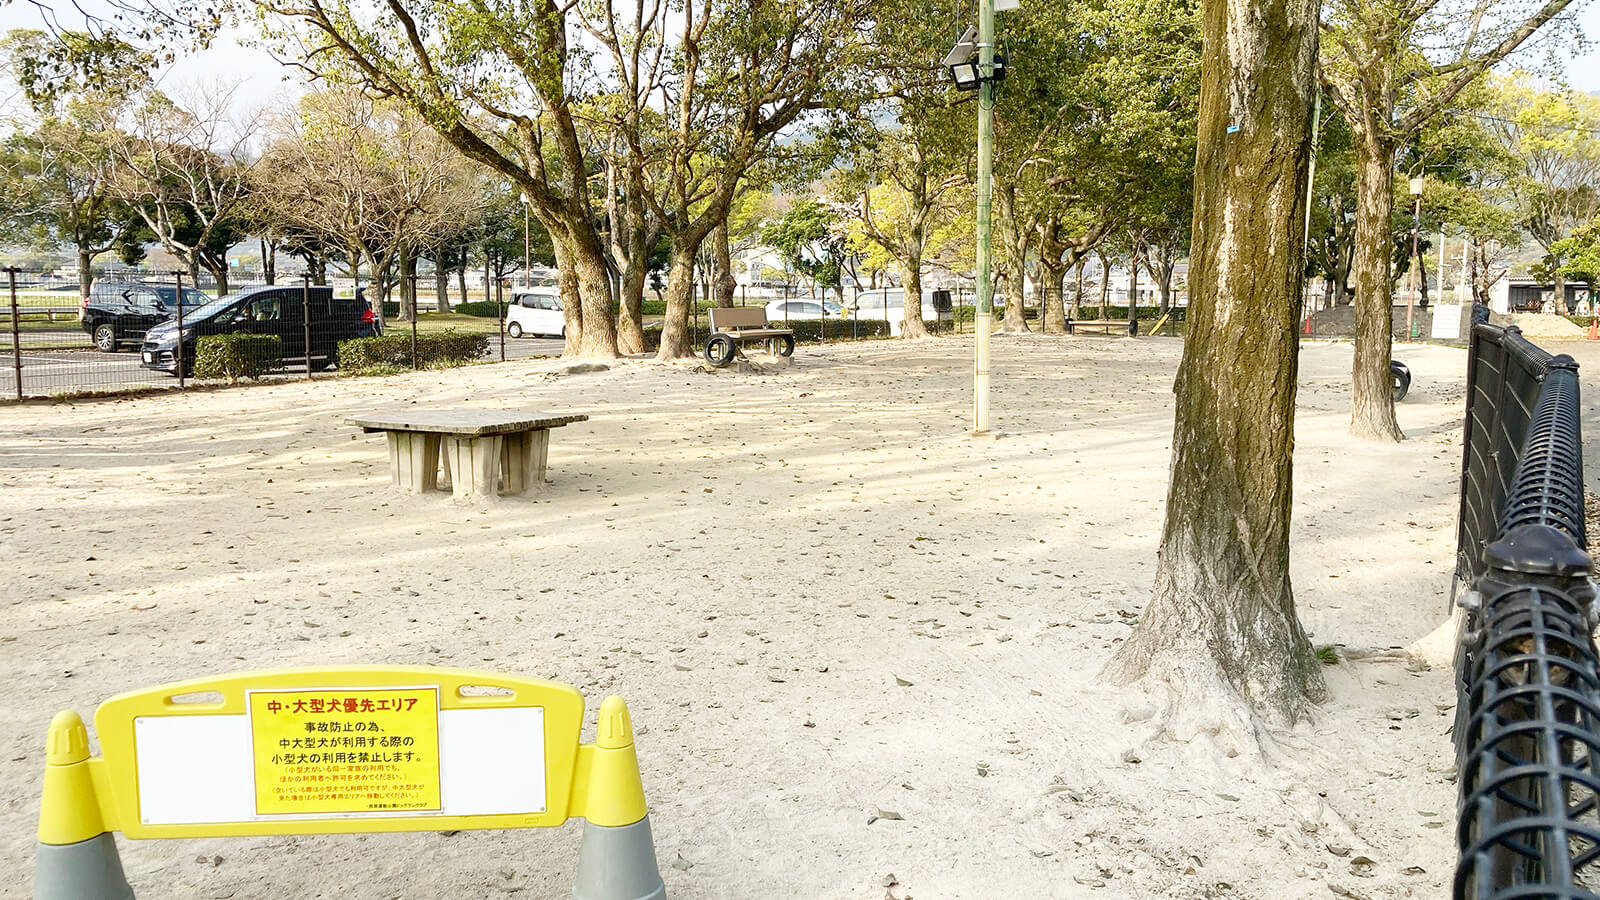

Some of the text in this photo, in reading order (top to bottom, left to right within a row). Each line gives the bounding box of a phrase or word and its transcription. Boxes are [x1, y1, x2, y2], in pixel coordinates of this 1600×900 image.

[267, 697, 419, 715] 中・大型犬優先エリア
[304, 721, 386, 733] 事故防止の為、
[279, 735, 414, 749] 中大型犬が利用する際の
[271, 751, 421, 765] 小型犬の利用を禁止します。
